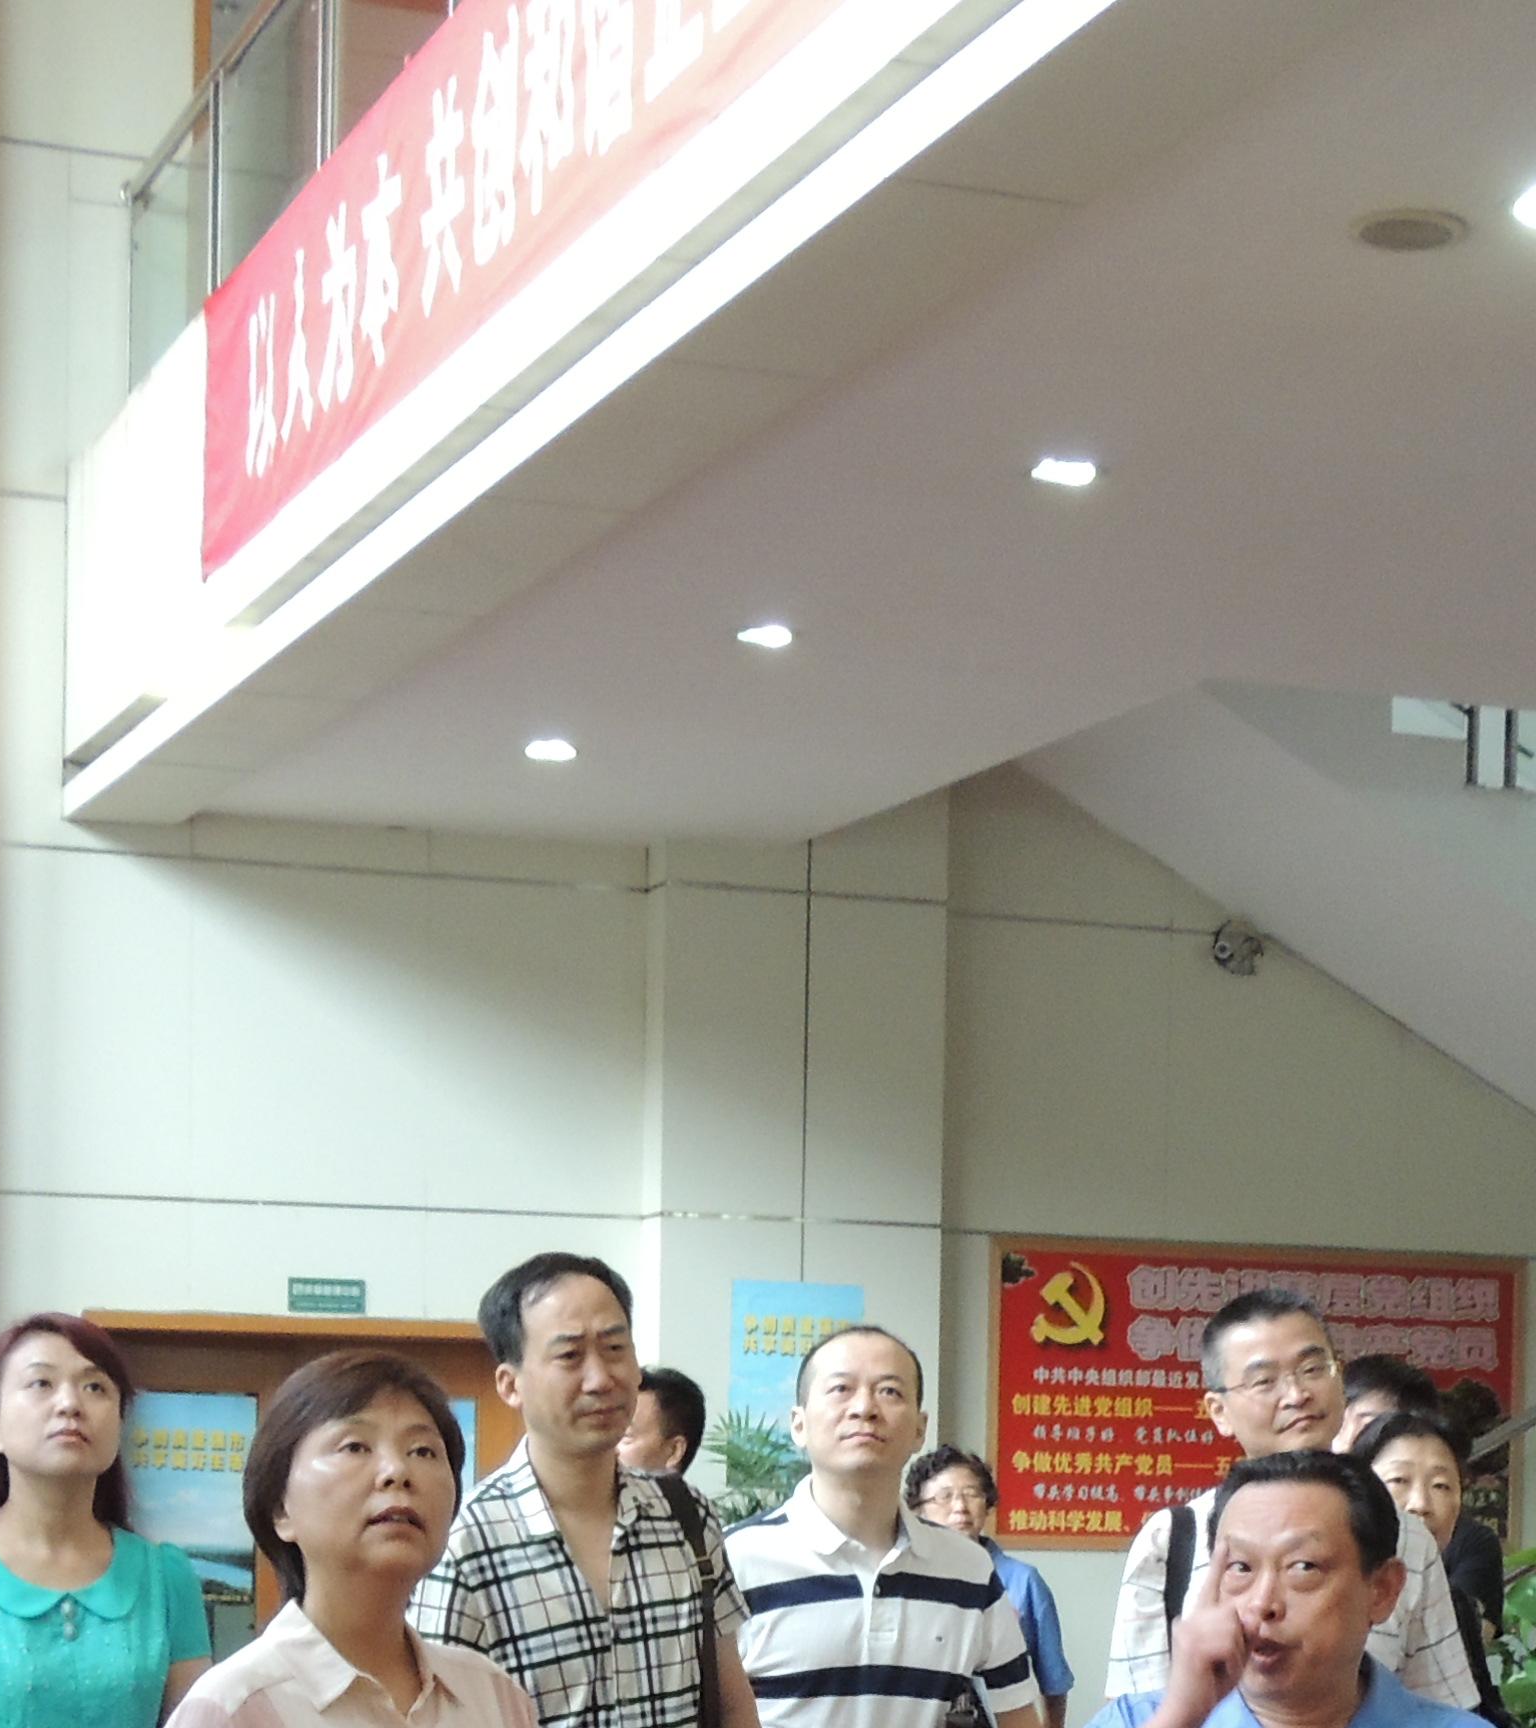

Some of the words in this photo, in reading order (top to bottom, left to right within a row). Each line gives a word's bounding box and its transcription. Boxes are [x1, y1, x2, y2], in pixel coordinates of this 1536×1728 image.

[245, 153, 402, 478] 以人为本
[1033, 1366, 1206, 1389] 中共中央组织部最近发
